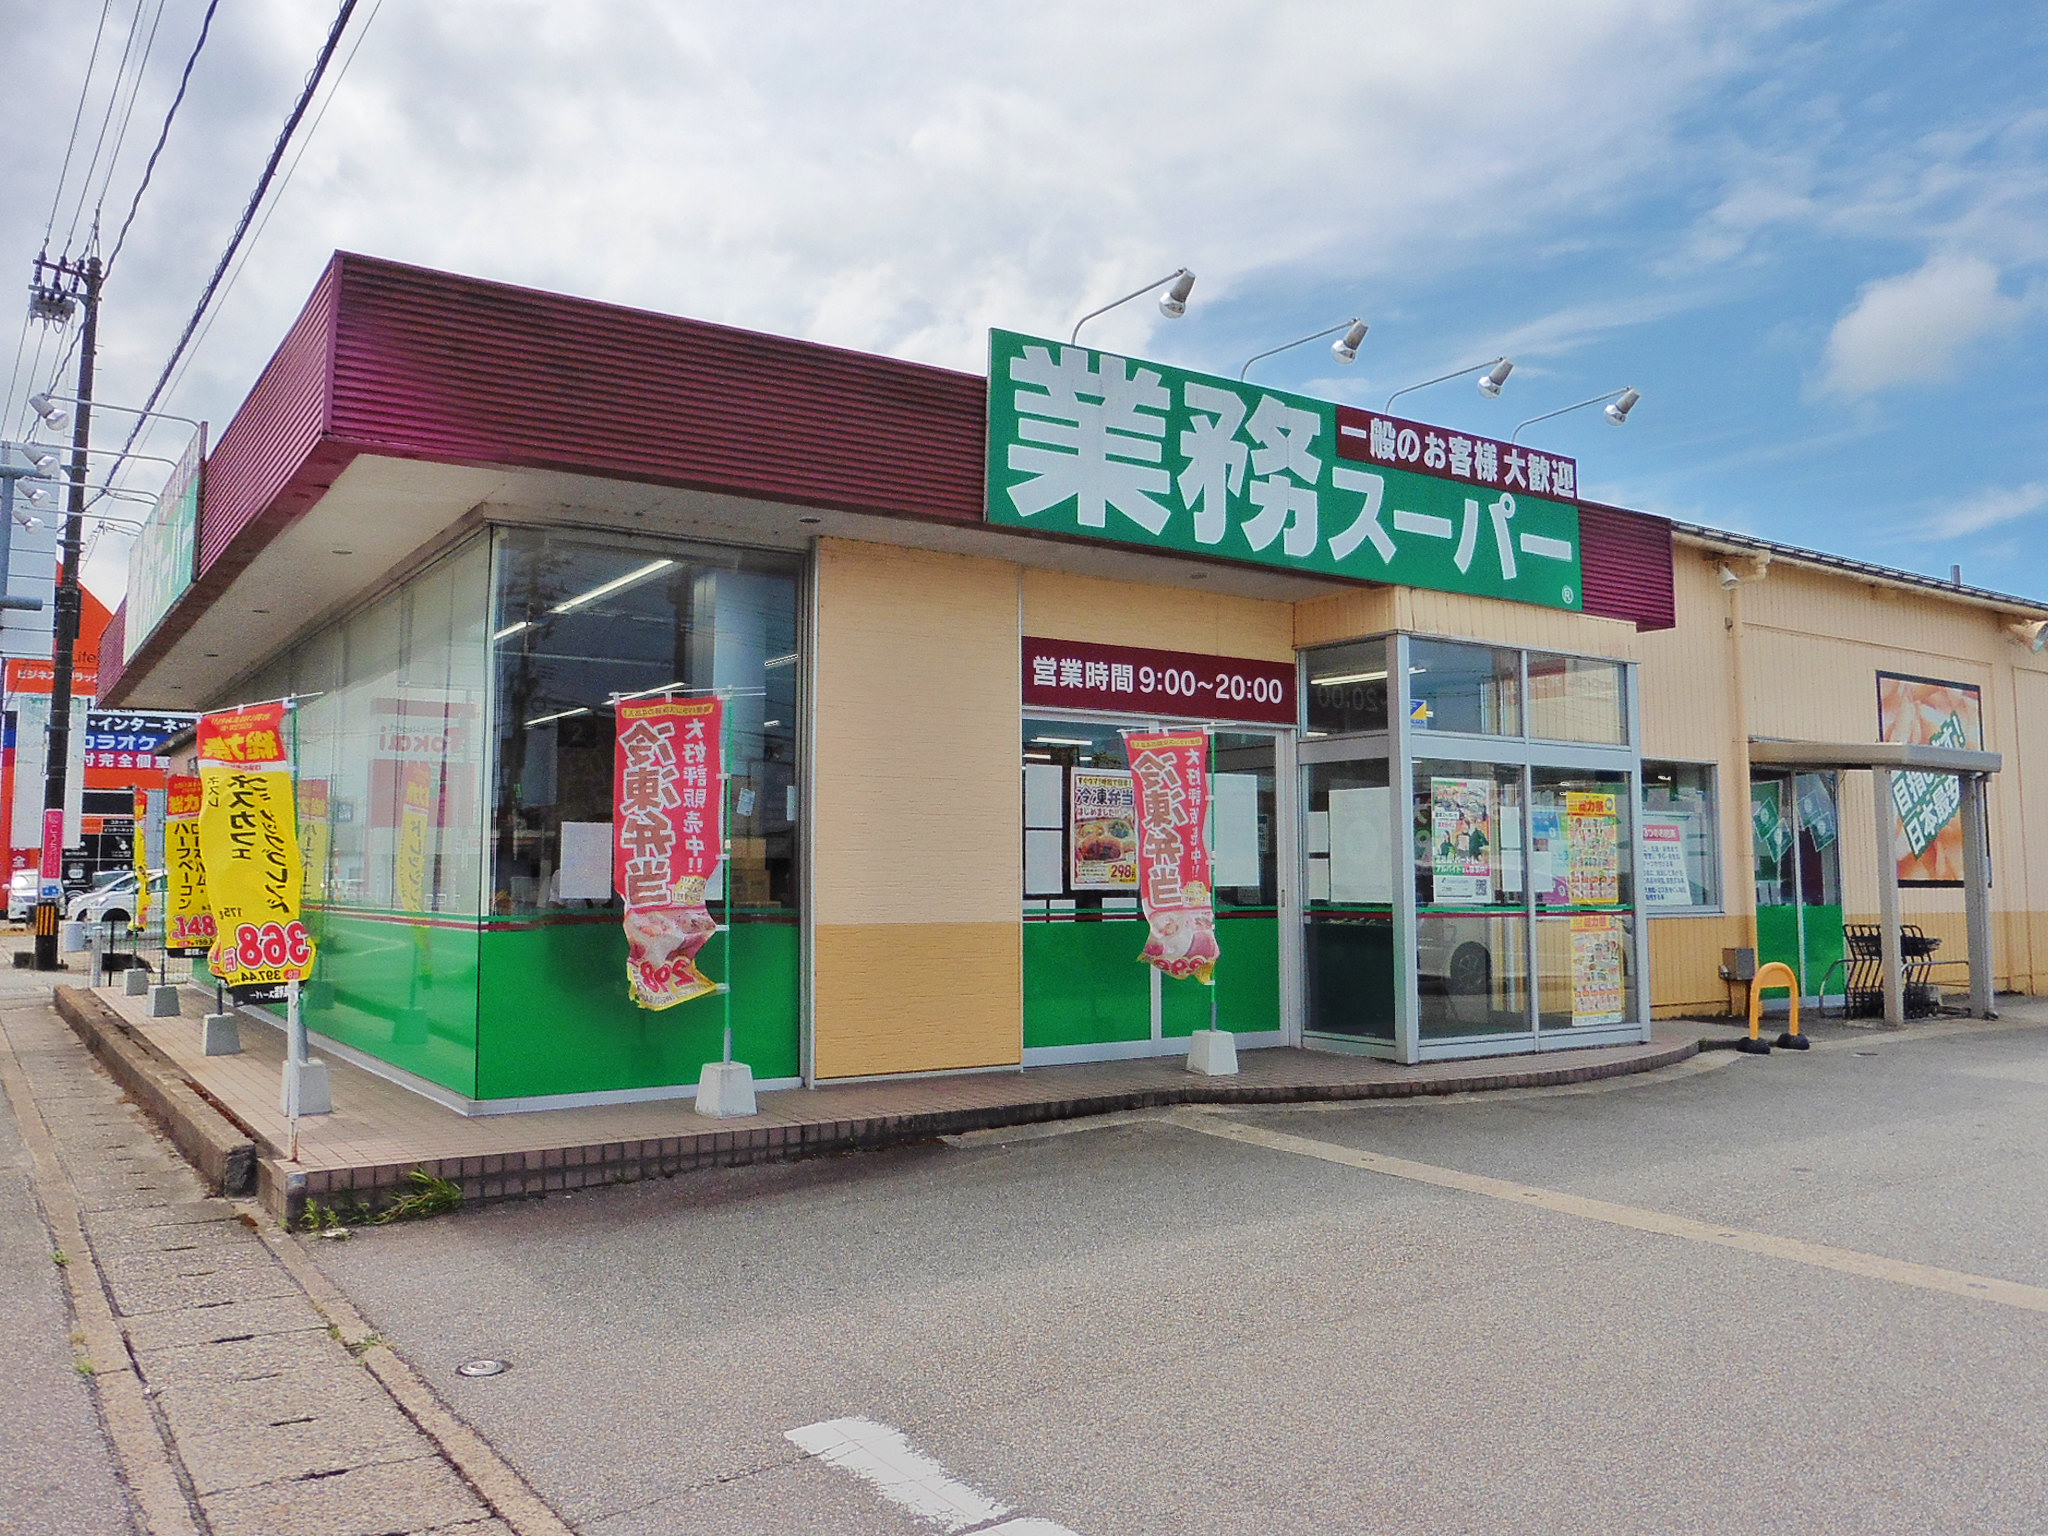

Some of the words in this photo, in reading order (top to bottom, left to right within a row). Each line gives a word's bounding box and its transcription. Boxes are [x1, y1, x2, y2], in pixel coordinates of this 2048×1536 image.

[1006, 345, 1572, 580] 業務スーパー
[1340, 418, 1498, 483] 一般のお客様
[1503, 451, 1576, 499] 大歓迎
[1033, 655, 1134, 693] 営業時間
[1076, 787, 1134, 806] 冷凍弁当
[174, 823, 194, 910] ハーフベーコン
[1110, 865, 1132, 878] 298
